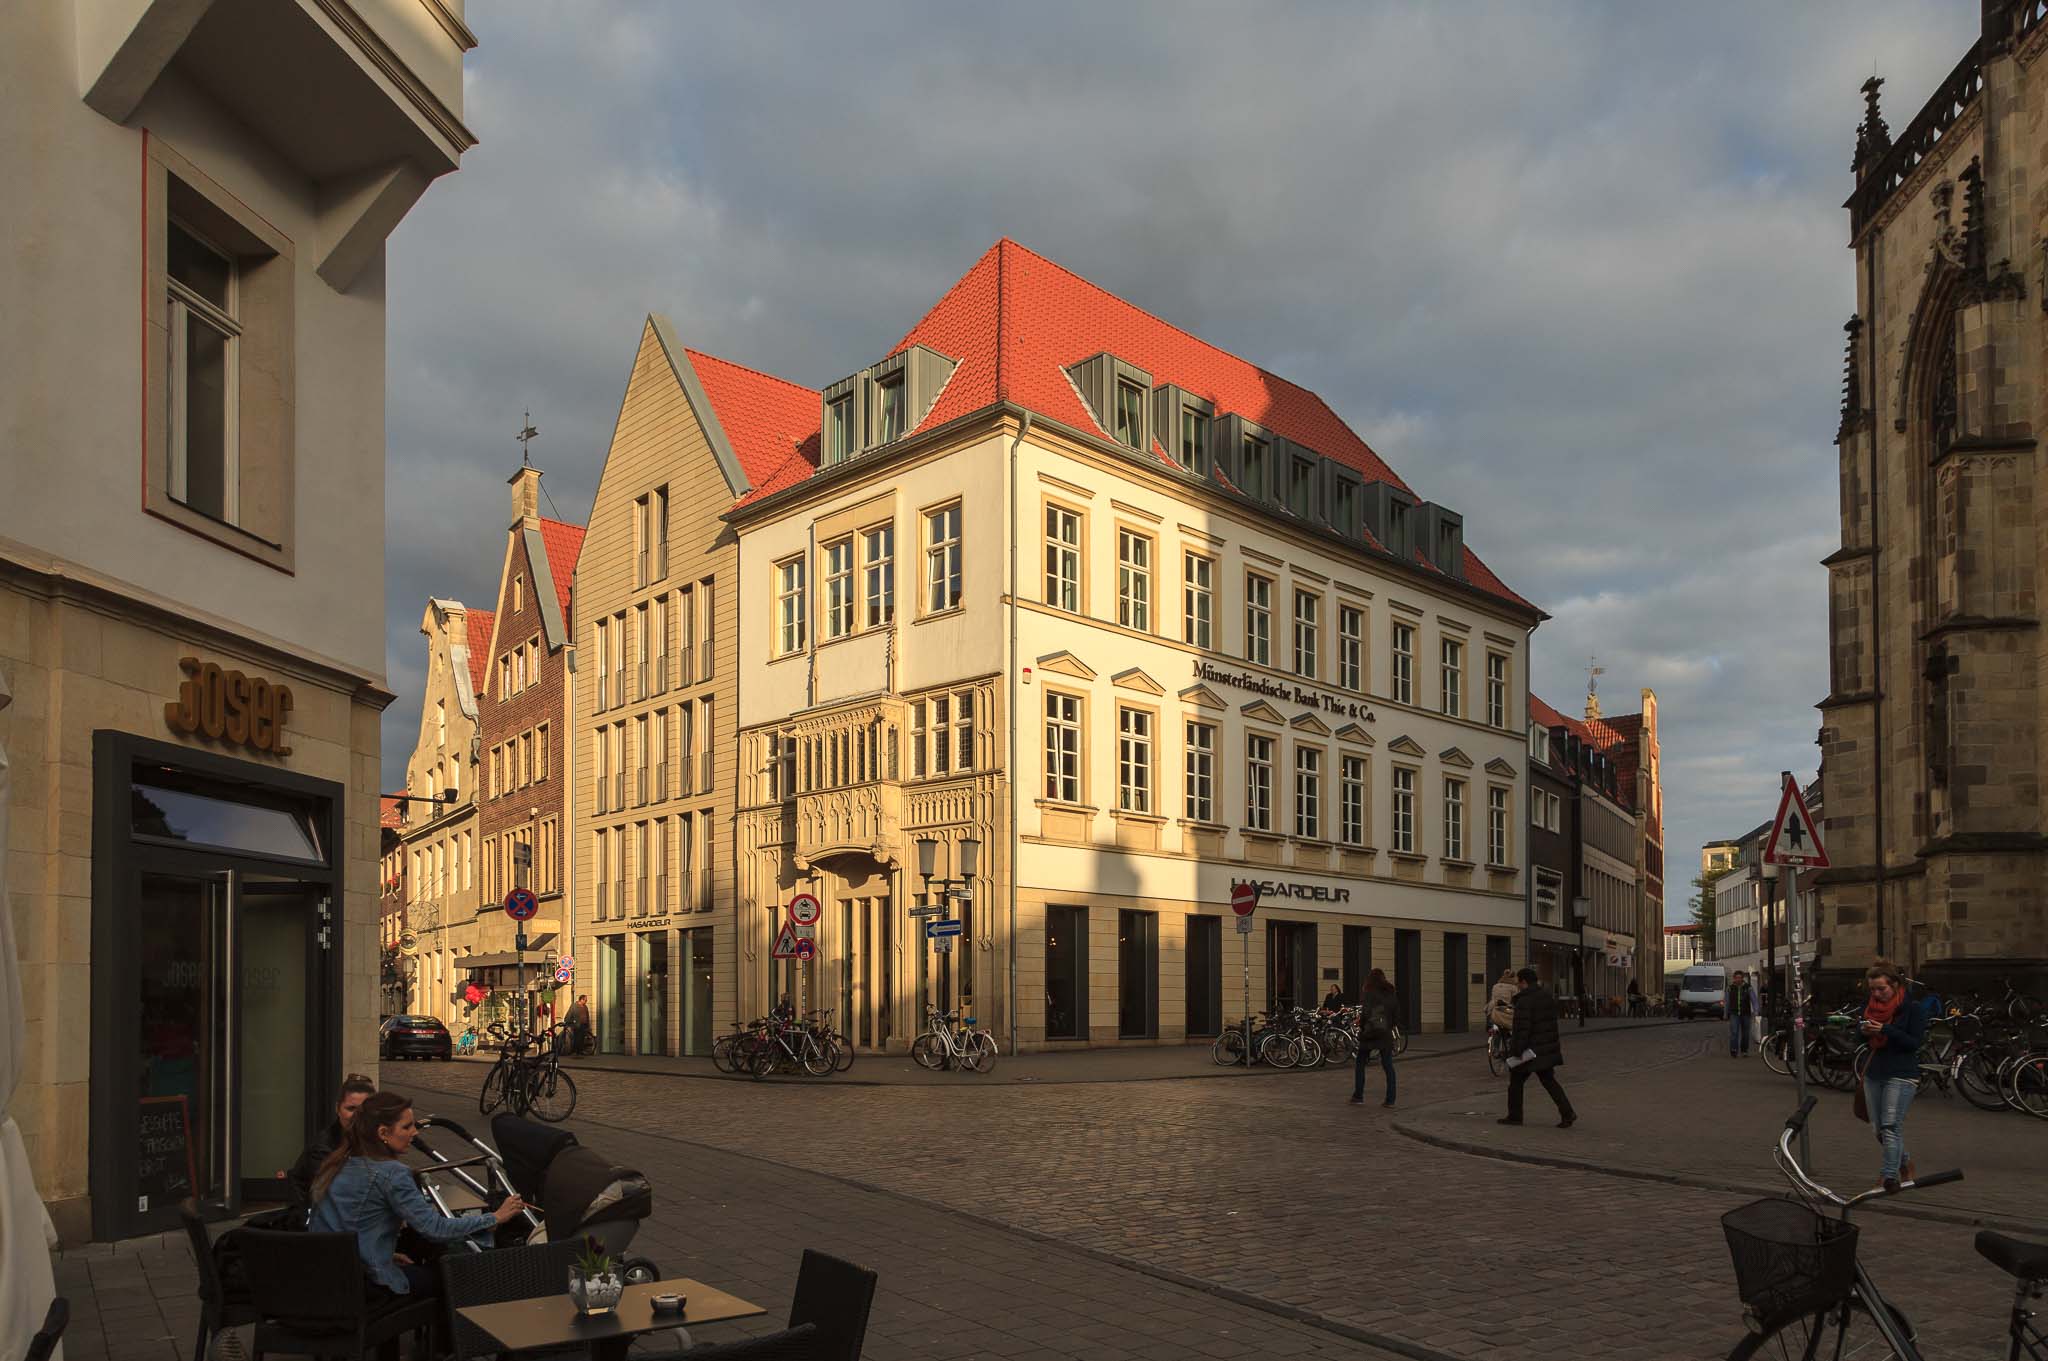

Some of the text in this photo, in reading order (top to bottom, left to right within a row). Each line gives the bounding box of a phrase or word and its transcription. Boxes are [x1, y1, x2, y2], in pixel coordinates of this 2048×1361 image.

[1192, 659, 1376, 722] Münsterländische Bank Thie & Co.
[627, 918, 671, 929] HASARDEUR
